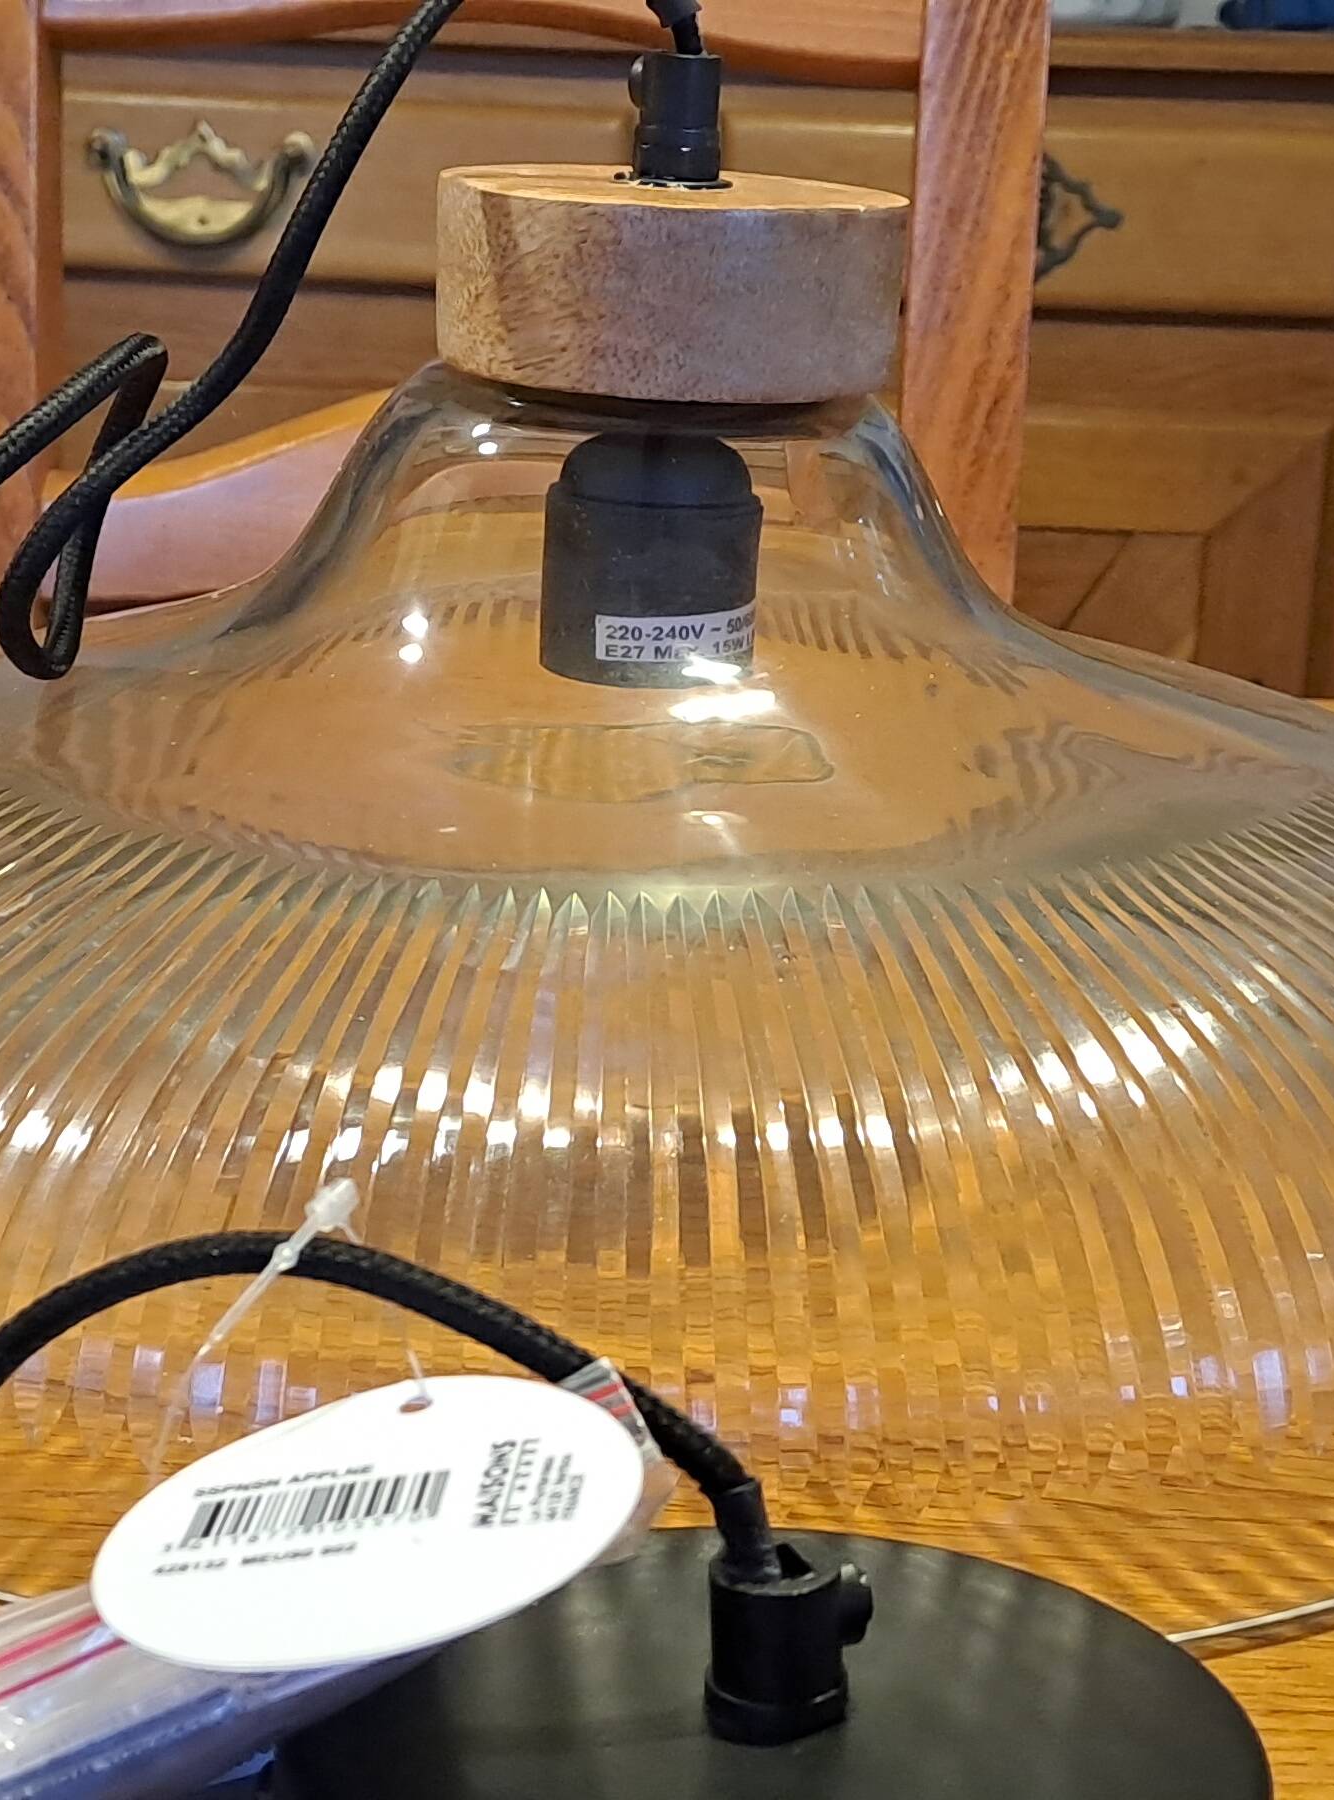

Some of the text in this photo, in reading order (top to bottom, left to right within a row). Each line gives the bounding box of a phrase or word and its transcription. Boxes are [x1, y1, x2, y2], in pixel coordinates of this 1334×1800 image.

[605, 623, 705, 641] 220-240V
[605, 645, 644, 659] E27
[473, 1439, 516, 1526] MAISONS
